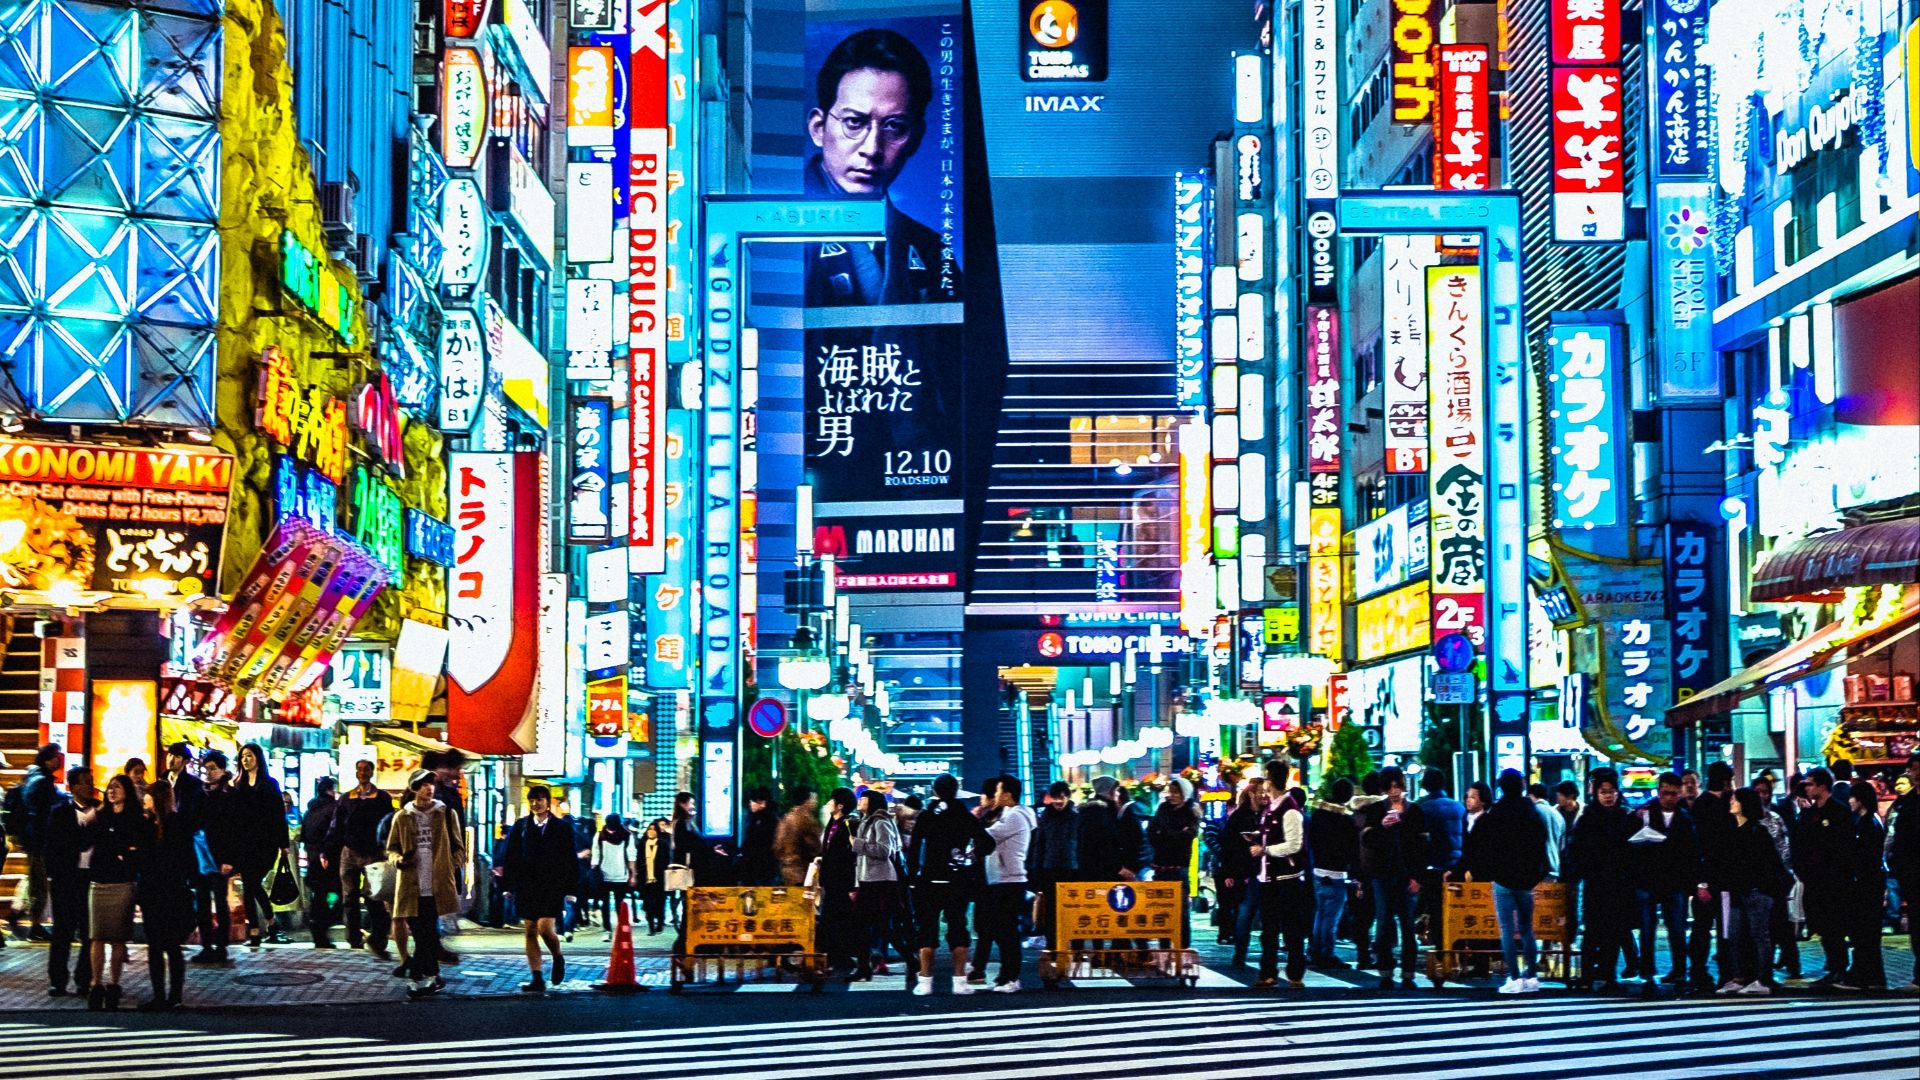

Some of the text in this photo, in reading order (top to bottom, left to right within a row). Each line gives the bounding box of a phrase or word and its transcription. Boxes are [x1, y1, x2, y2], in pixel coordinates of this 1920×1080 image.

[1025, 95, 1102, 112] IMAX
[1556, 73, 1620, 190] 笑笑
[940, 22, 956, 297] この男の生きざまが、日本の未来を変えた。
[1776, 127, 1807, 176] Don
[630, 153, 657, 334] BIC DRUG
[447, 284, 470, 297] 1F
[817, 343, 922, 388] 海賊と
[1674, 351, 1705, 373] 5F
[447, 408, 469, 422] B1
[816, 388, 914, 413] よばれた
[816, 415, 855, 458] 男
[1306, 377, 1340, 463] 甘太郎
[1561, 330, 1611, 519] カラオケ
[147, 453, 232, 489] YAKI
[709, 276, 733, 652] GODZILLA ROAD
[884, 449, 952, 475] 12.10
[66, 484, 110, 501] dinner
[112, 487, 141, 502] with
[884, 475, 950, 486] ROADSHOW
[1312, 473, 1339, 489] 4F
[1312, 489, 1339, 504] 3F
[64, 501, 106, 517] Drinks
[109, 503, 128, 519] for
[130, 506, 140, 519] 2
[142, 505, 181, 521] hours
[1435, 463, 1486, 586] 金の蔵
[457, 466, 487, 599] トラノコ
[856, 527, 956, 554] MARUHAN
[1435, 597, 1475, 629] 2F
[1674, 531, 1710, 679] カラオケ
[1065, 635, 1122, 654] TOHO
[1621, 618, 1656, 741] カラオケ
